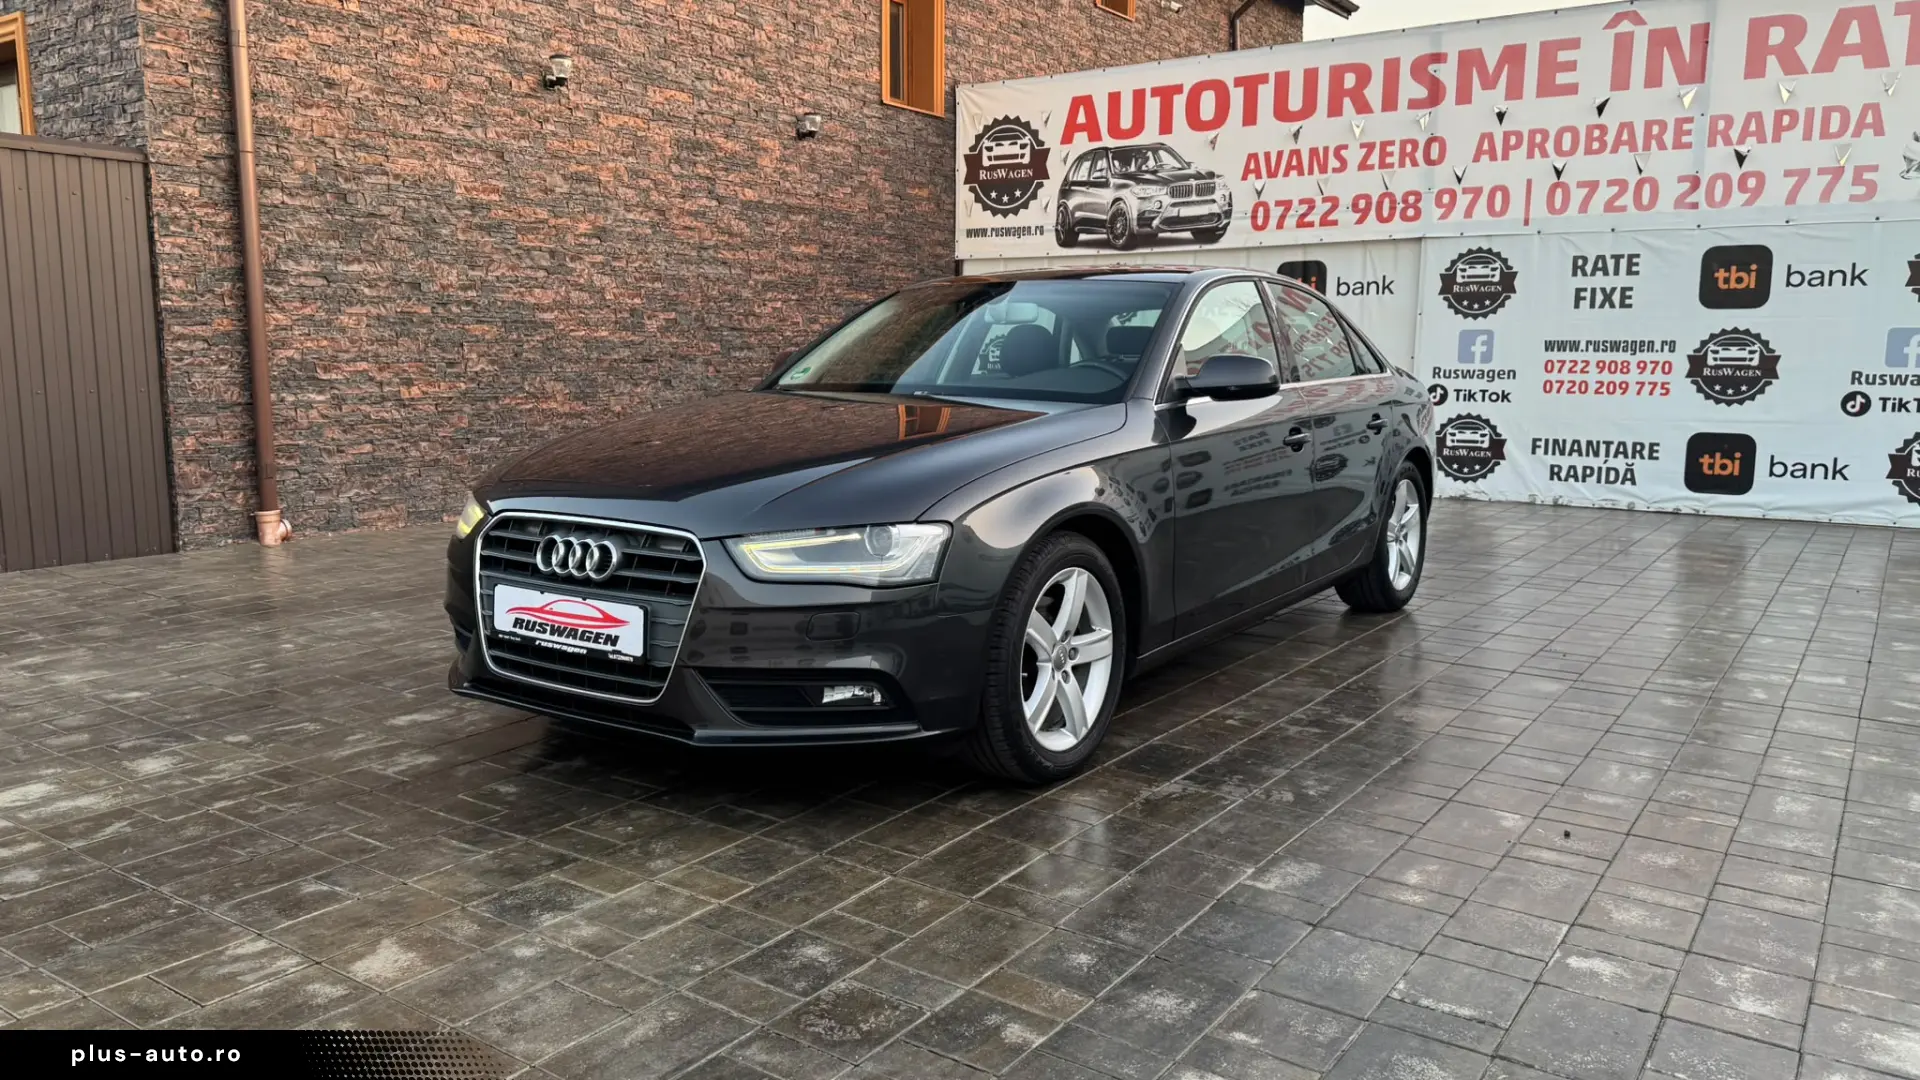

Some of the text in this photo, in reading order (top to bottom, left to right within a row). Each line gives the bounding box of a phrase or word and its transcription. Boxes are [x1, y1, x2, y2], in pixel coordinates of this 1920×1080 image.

[1060, 37, 1581, 145] AUTOTURISME
[1603, 10, 1711, 92] ÎN
[1241, 104, 1885, 182] AVANS ZERO APROBARE RAPIDA
[1250, 197, 1340, 233] 0722
[1351, 191, 1422, 226] 908
[1434, 186, 1511, 220] 970
[1545, 178, 1661, 217] 0720
[1674, 171, 1767, 210] 209
[1783, 163, 1881, 207] 775
[965, 226, 1045, 239] www.ruswagen.ro
[1571, 254, 1641, 278] RATE
[1715, 263, 1869, 290] tbi bank
[1336, 275, 1395, 297] bank
[1573, 287, 1634, 310] FIXE
[1544, 340, 1677, 356] www.ruswagen.ro
[1432, 367, 1517, 383] Ruswagen
[1544, 360, 1674, 376] 0722 908 970
[1453, 389, 1512, 403] TikTok
[1543, 380, 1671, 398] 0720 209 775
[1549, 462, 1637, 486] RAPIDĂ
[1699, 452, 1850, 480] tbi bank
[512, 617, 620, 647] RUSWAGEN
